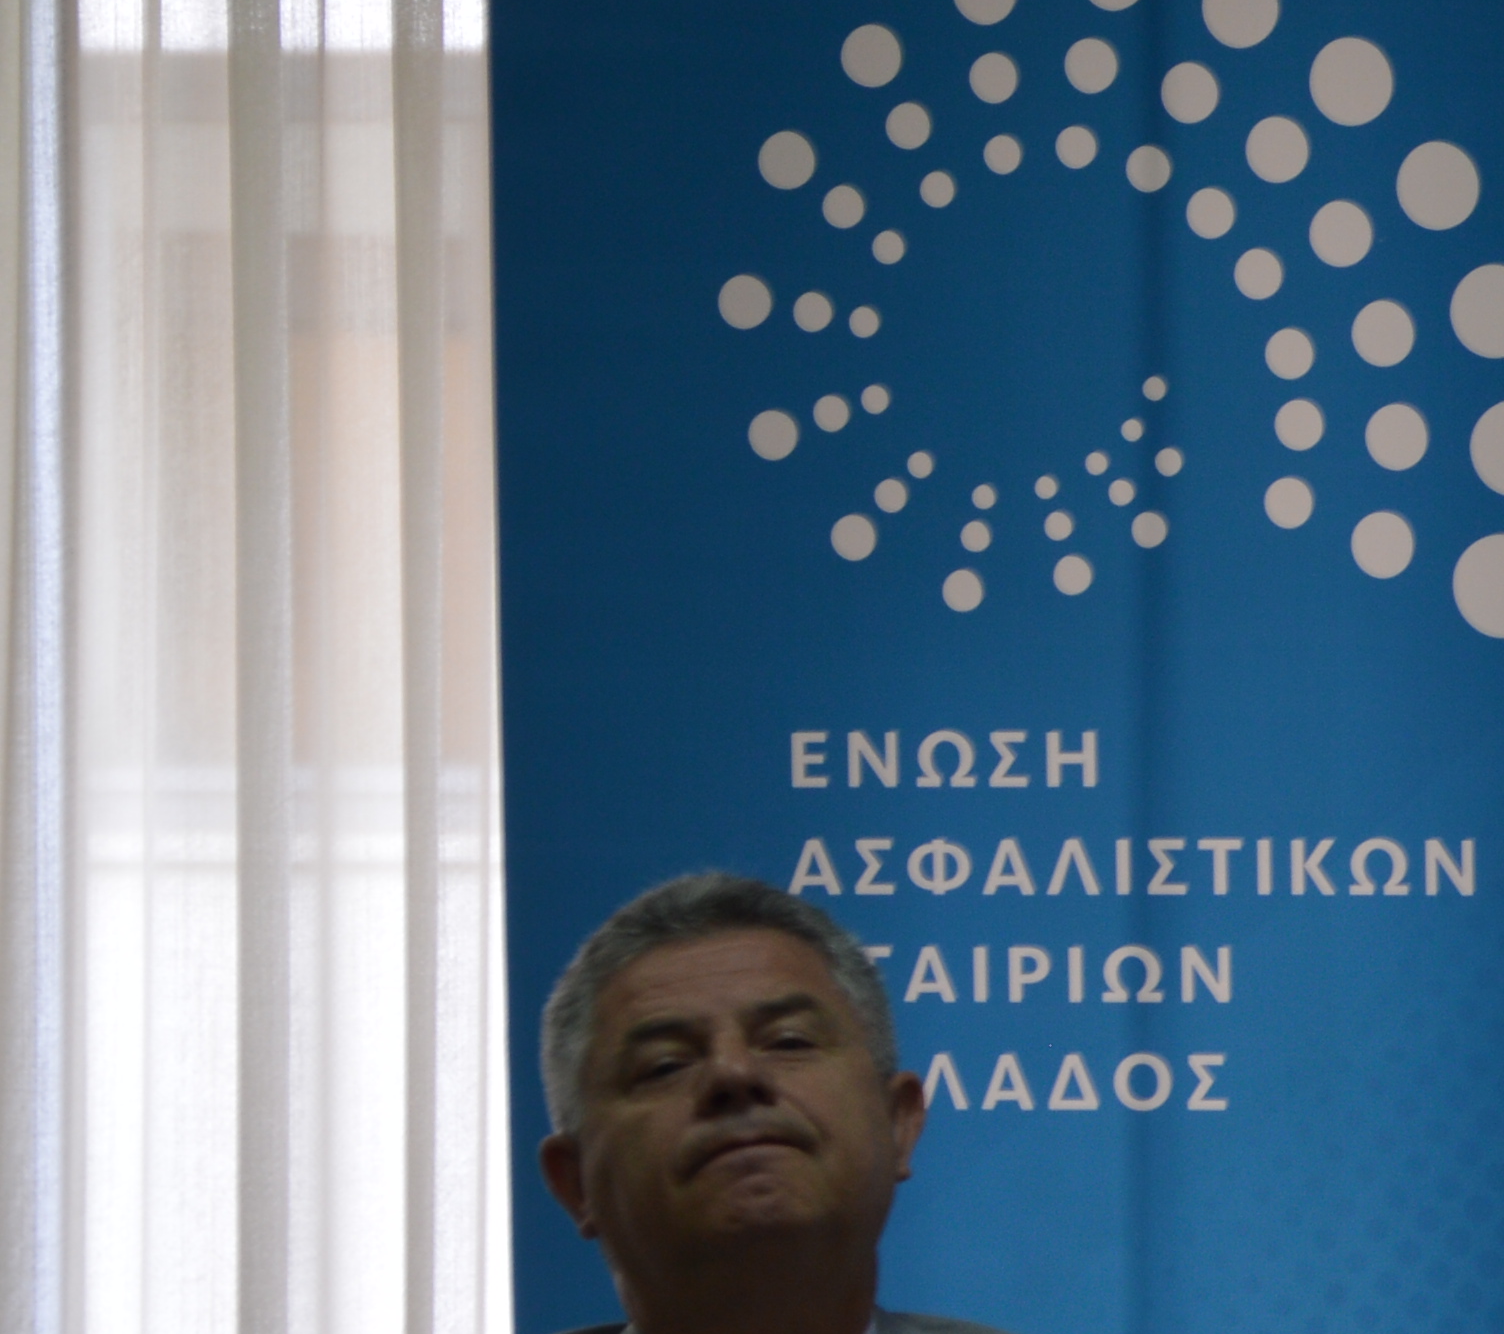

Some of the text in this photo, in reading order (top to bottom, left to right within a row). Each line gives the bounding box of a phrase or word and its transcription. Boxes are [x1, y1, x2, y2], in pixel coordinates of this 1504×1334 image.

[790, 729, 1099, 789] ΕΝΩΣΗ
[788, 836, 1477, 897] ΑΣΦΑΛΙΣΤΙΚΩΝ
[861, 944, 1233, 1005] ΑΙΡΙΩΝ
[922, 1051, 1230, 1113] ΛΑΔΟΣ
